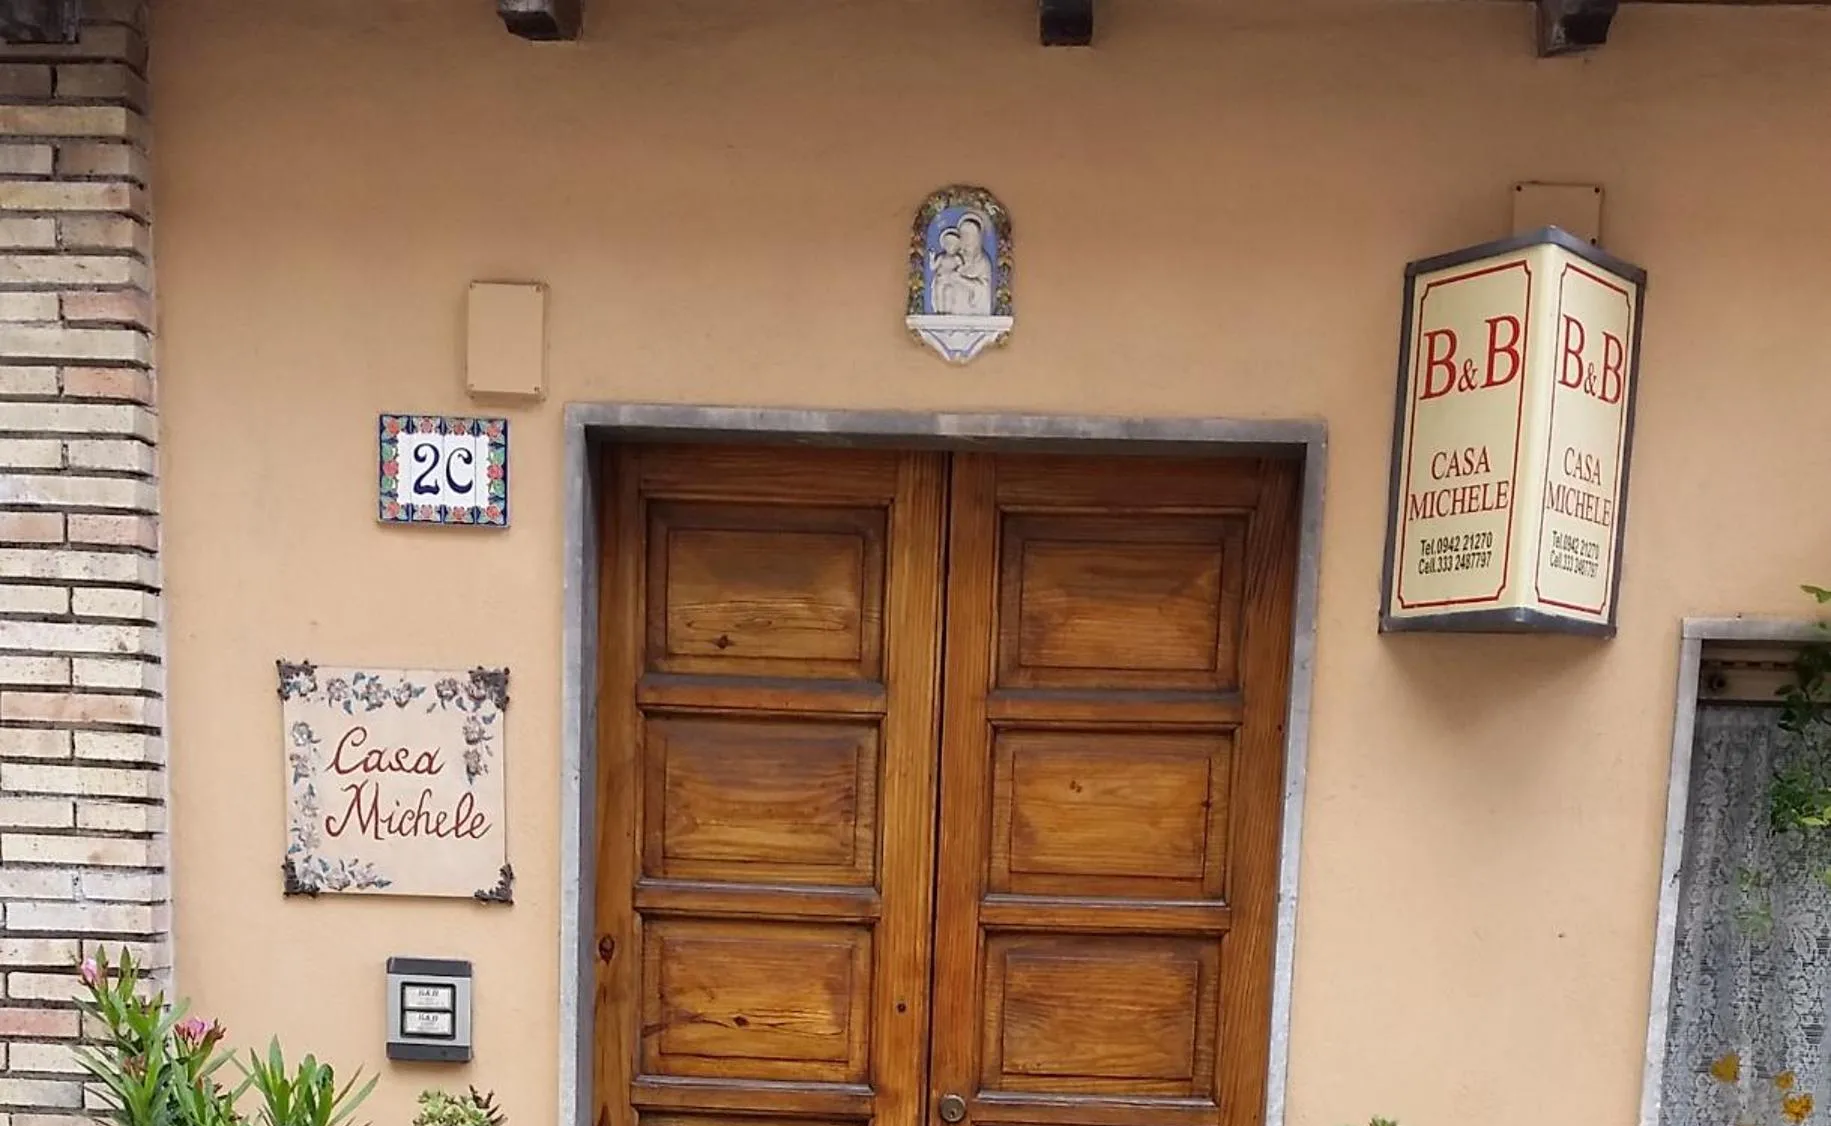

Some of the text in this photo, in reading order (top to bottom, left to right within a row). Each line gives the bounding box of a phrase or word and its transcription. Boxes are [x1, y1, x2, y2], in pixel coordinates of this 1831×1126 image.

[1419, 314, 1521, 400] B&B
[1558, 313, 1624, 405] B&B
[413, 442, 473, 495] 2C
[1431, 446, 1491, 480] CASA
[1563, 446, 1602, 486] CASA
[1408, 480, 1510, 521] MICHELE
[1546, 480, 1612, 527] MICHELE
[1462, 531, 1493, 551] 21270
[326, 726, 445, 775] Casa
[325, 779, 493, 841] Michele
